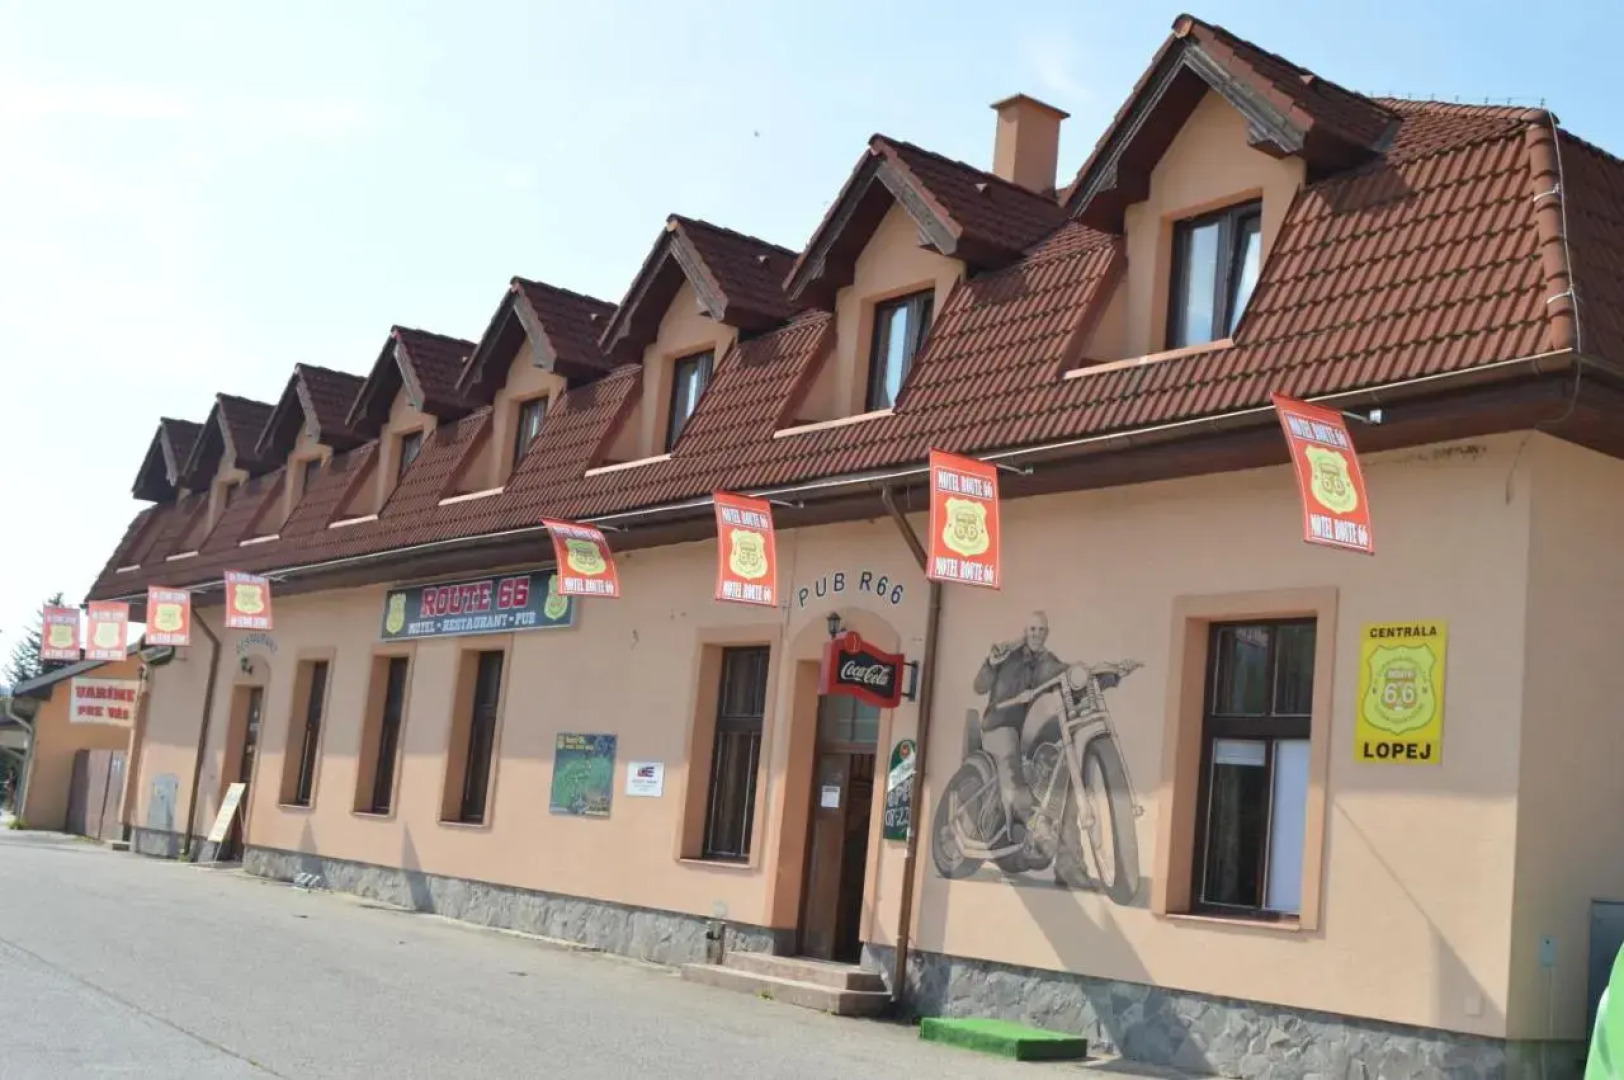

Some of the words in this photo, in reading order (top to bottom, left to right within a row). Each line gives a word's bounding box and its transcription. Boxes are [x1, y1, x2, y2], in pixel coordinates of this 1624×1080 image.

[961, 561, 982, 580] ROUTE
[983, 564, 994, 583] 66
[422, 582, 492, 617] ROUTE
[497, 576, 531, 609] 66
[798, 572, 846, 608] PUB
[859, 570, 904, 605] R66
[514, 612, 536, 625] PUB
[1369, 626, 1437, 638] CENTRÁLA
[1385, 683, 1415, 704] 66
[1363, 742, 1432, 760] LOPEJ
